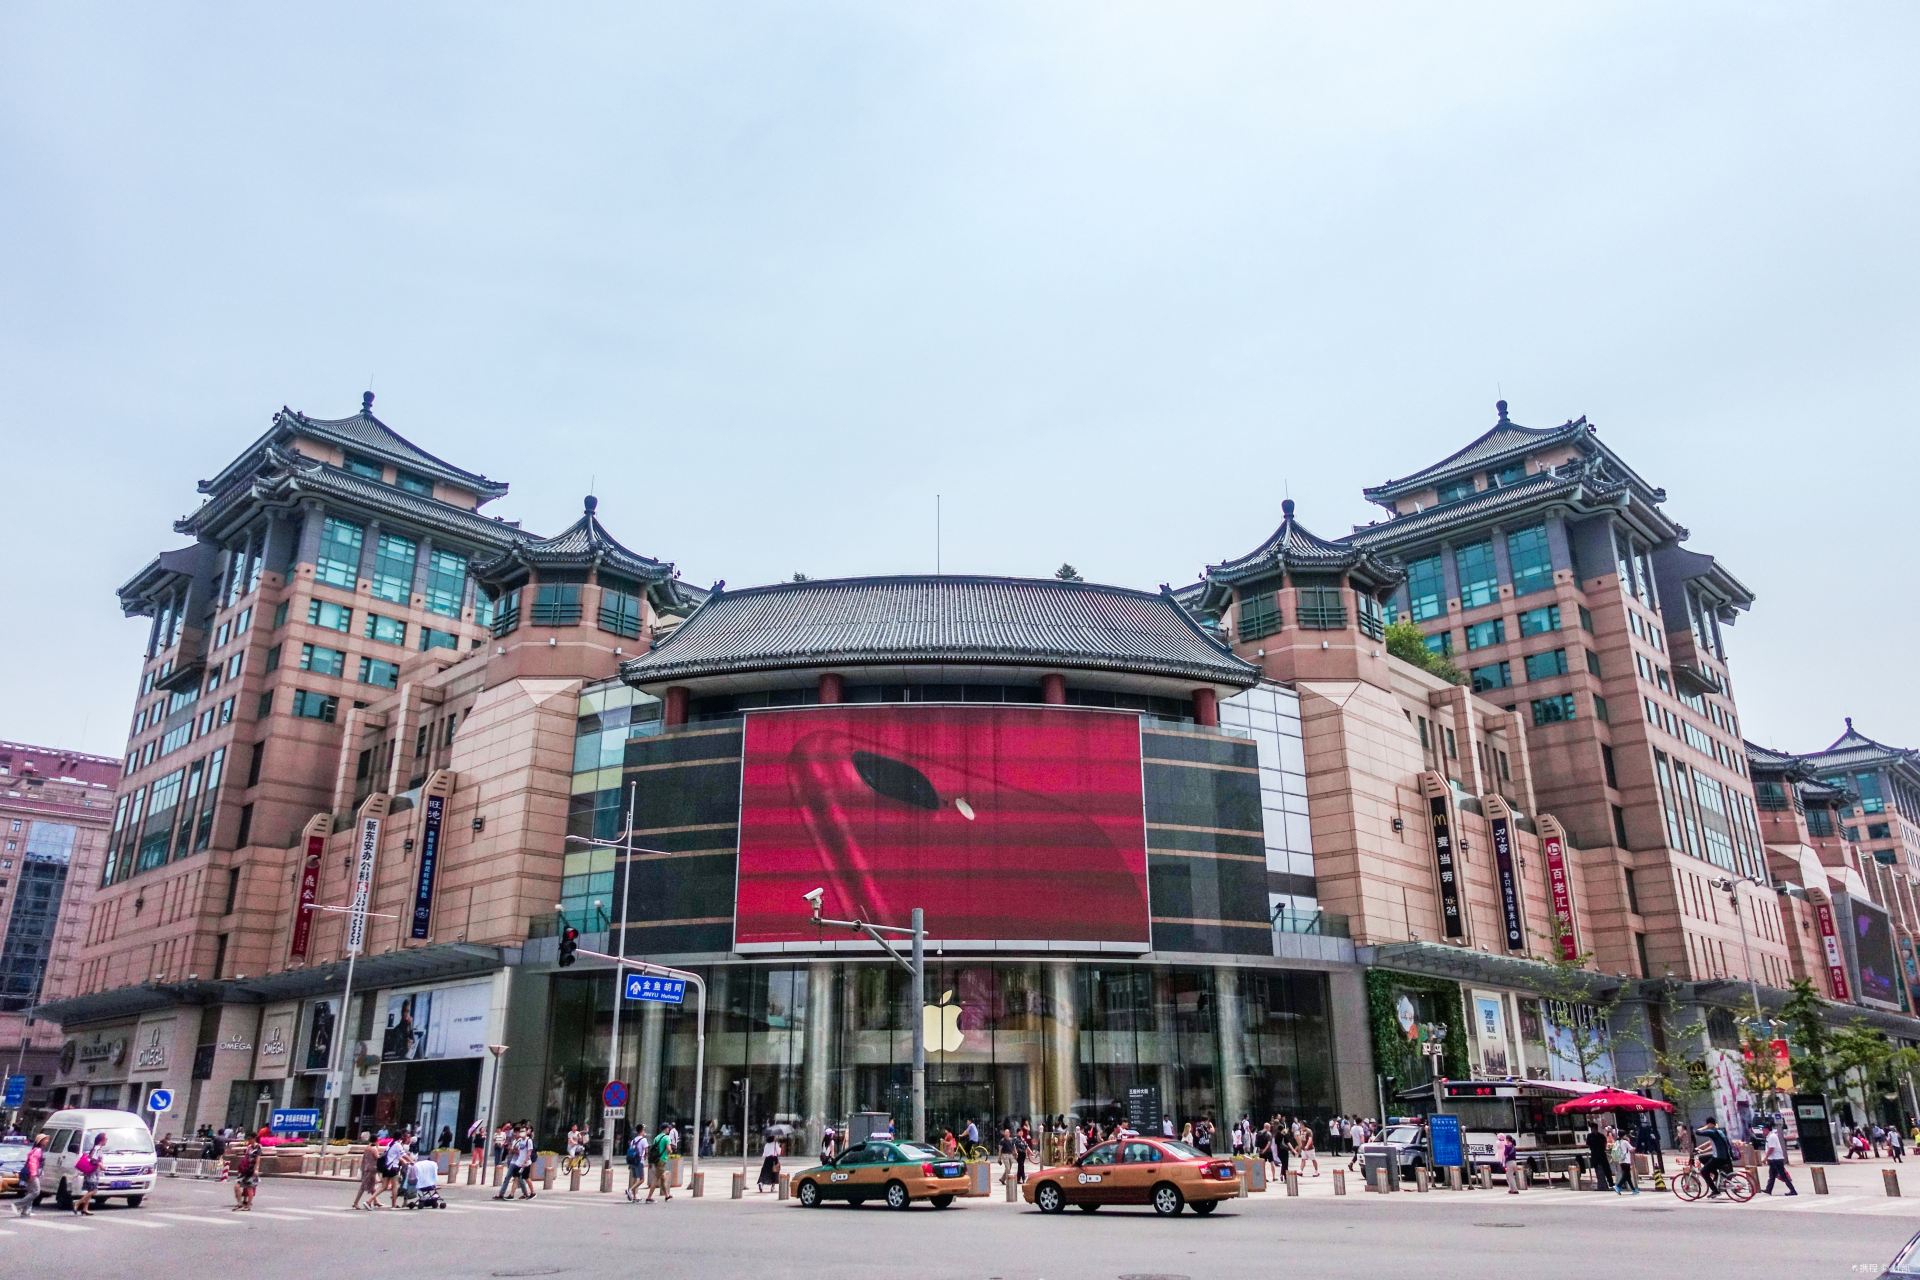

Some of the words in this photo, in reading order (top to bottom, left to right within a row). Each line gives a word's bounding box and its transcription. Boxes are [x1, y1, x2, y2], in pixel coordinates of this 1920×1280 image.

[1437, 836, 1453, 882] 麦当劳
[1446, 905, 1457, 914] 24
[642, 980, 682, 993] 金鱼胡同
[220, 1042, 252, 1050] OMEGA
[263, 1041, 284, 1056] OMEGA
[138, 1047, 165, 1066] OMEGA
